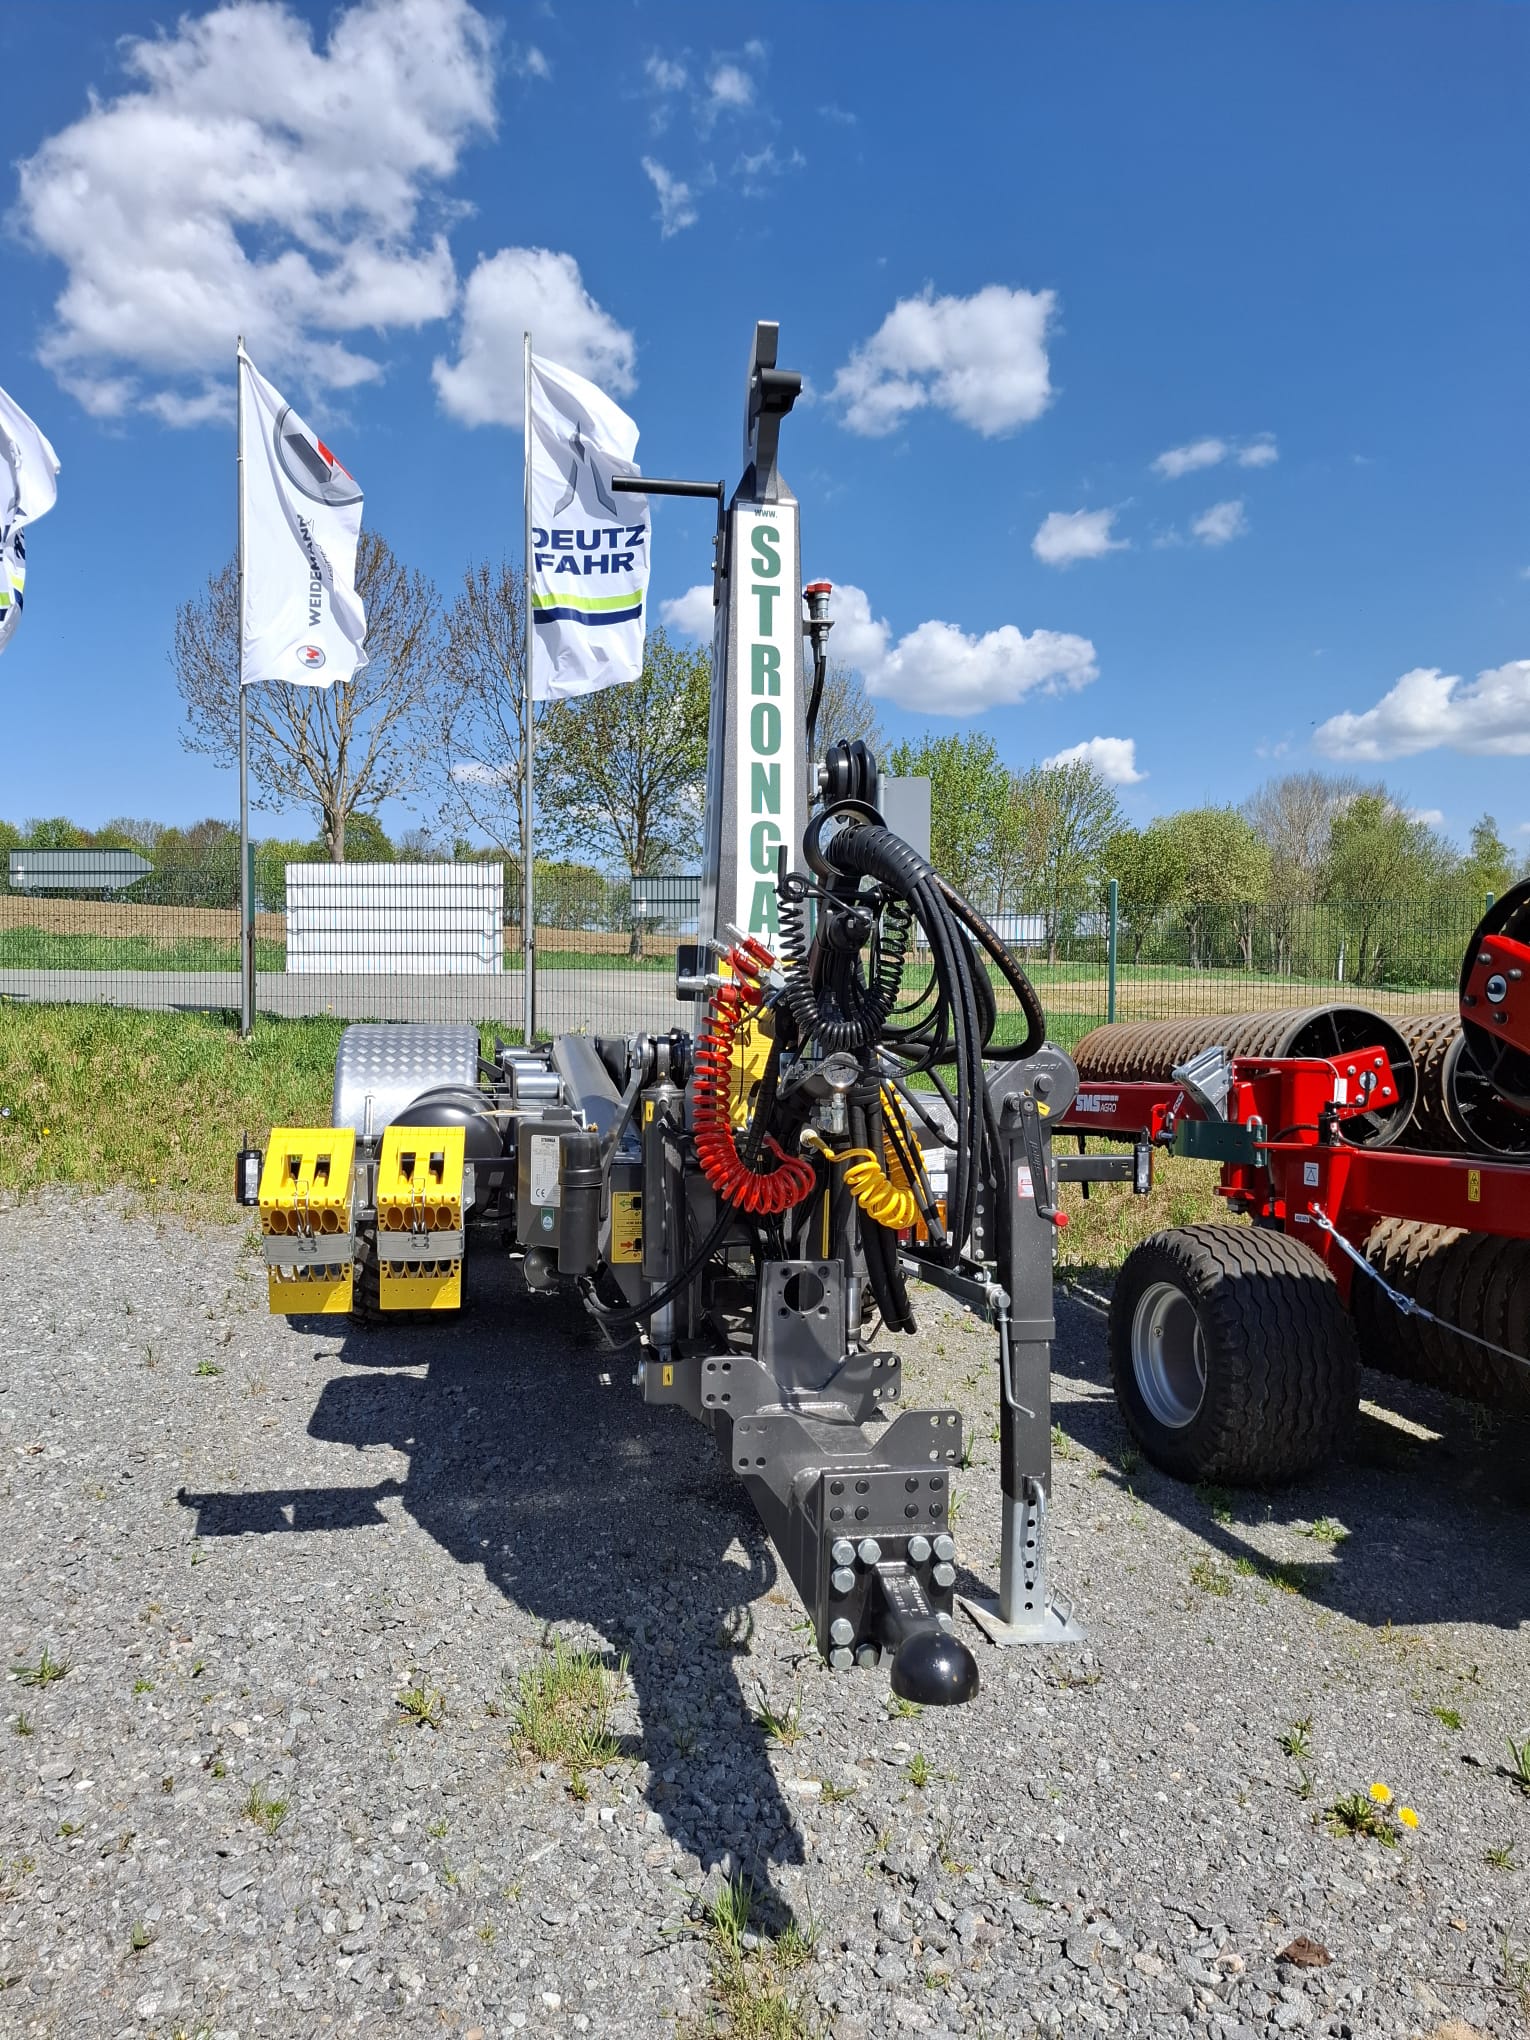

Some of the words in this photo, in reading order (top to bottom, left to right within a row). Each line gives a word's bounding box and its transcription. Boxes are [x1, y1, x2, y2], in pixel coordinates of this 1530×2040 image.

[532, 524, 646, 550] DEUTZ
[534, 552, 635, 575] FAHR
[748, 525, 782, 934] STRONGA
[1075, 1094, 1100, 1112] SMS
